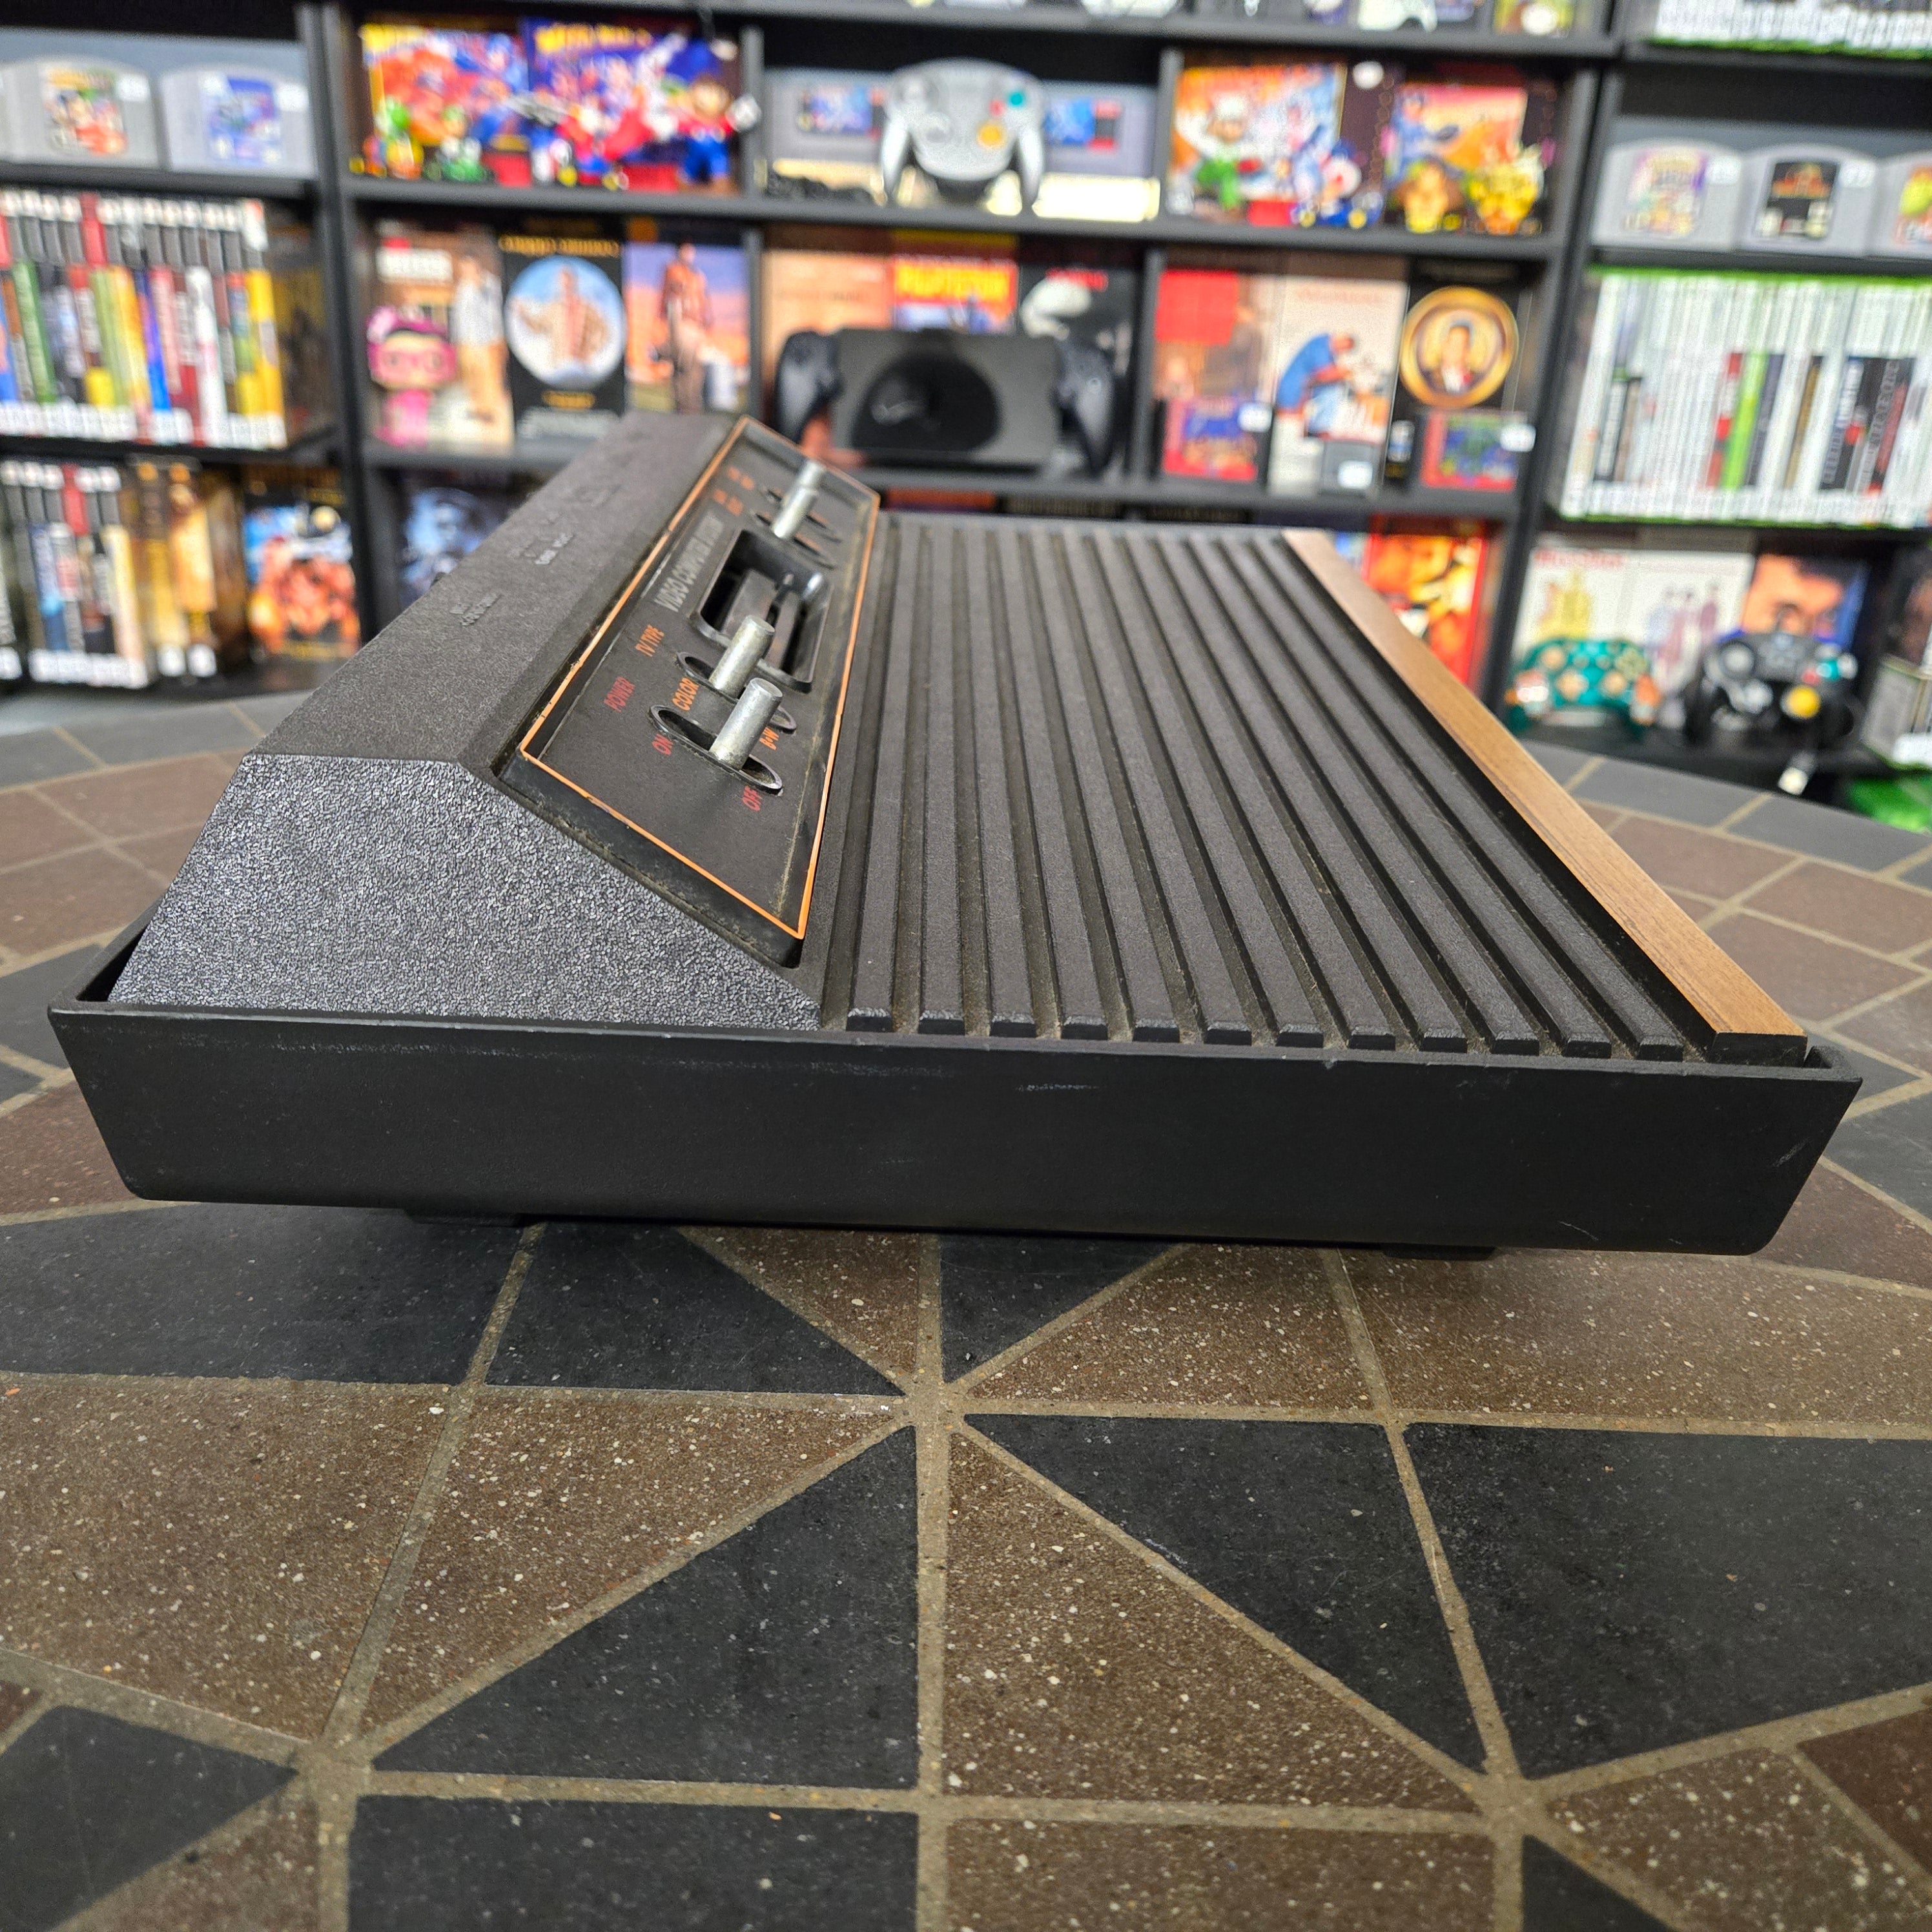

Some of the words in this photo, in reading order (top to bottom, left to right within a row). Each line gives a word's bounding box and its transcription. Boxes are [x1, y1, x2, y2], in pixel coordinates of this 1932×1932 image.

[653, 577, 689, 612] VIDEO
[641, 624, 664, 646] TYPE
[635, 640, 655, 657] TV
[604, 676, 635, 712] POWER
[672, 678, 699, 710] COLOR
[652, 734, 673, 755] ON
[742, 786, 763, 812] OFF
